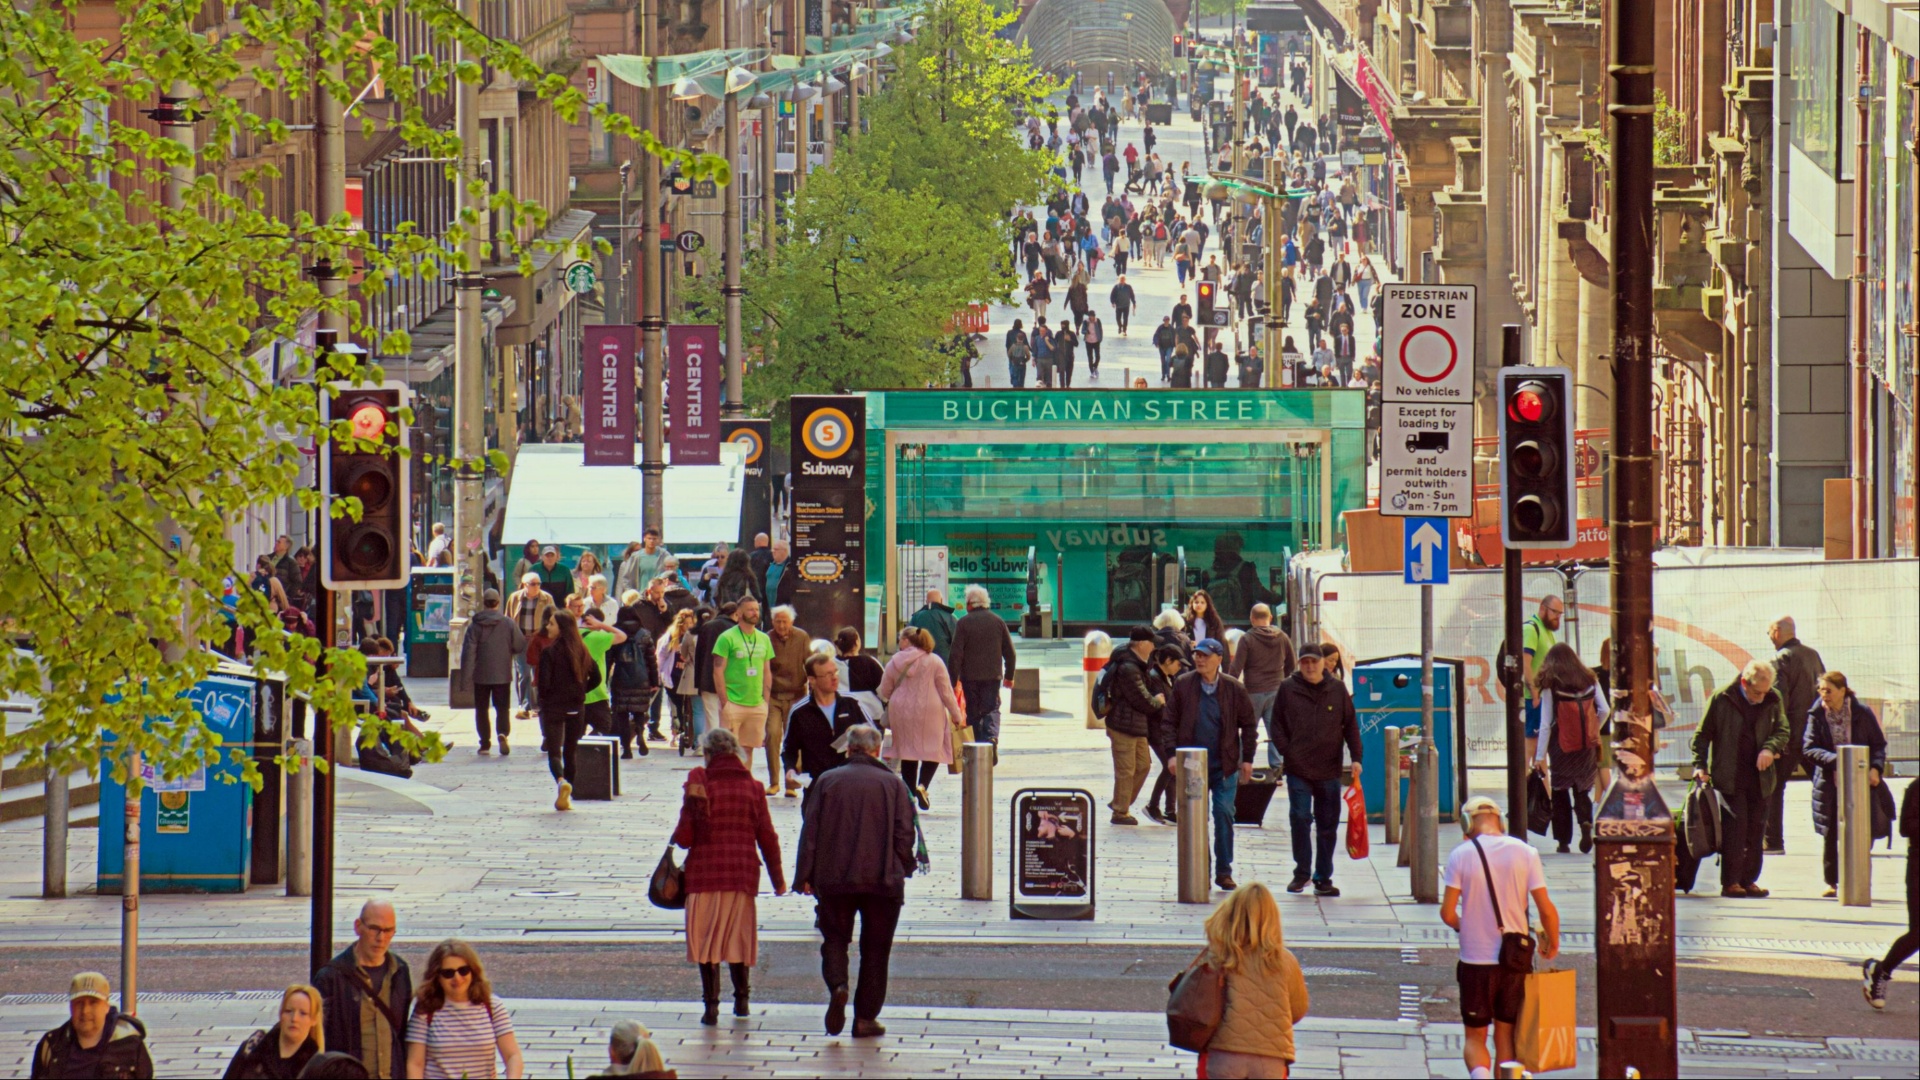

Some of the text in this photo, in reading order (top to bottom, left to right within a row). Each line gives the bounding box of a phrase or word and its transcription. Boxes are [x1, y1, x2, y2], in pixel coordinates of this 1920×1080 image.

[1391, 290, 1468, 300] PEDESTRIAN
[1401, 304, 1456, 319] ZONE
[1396, 386, 1460, 396] No vehicles
[943, 400, 1277, 420] BUCHANAN STREET
[1398, 407, 1456, 418] Except for
[1398, 418, 1456, 430] loading by
[1416, 456, 1437, 465] and
[744, 466, 763, 478] way
[802, 462, 854, 479] Subway
[1386, 467, 1468, 478] permit holders
[1405, 478, 1448, 488] outwith
[1401, 490, 1424, 499] Mon
[1433, 490, 1455, 500] Sun
[1408, 503, 1424, 511] am
[1577, 528, 1610, 543] atfo
[948, 558, 1030, 573] ello Subwa
[1466, 737, 1506, 752] Refurbis
